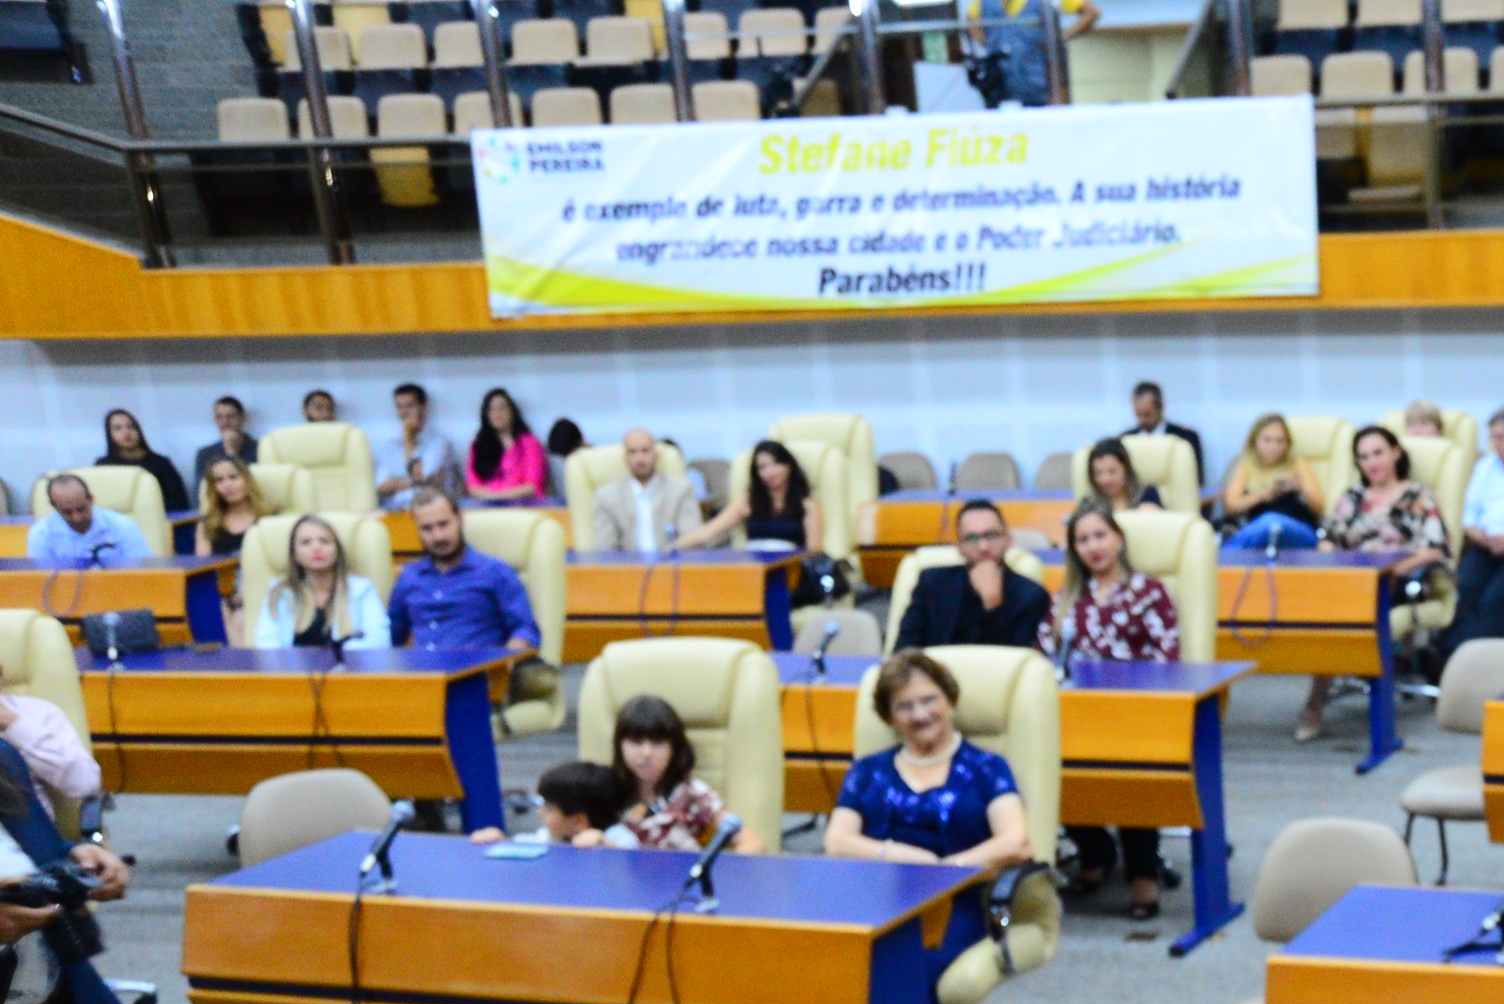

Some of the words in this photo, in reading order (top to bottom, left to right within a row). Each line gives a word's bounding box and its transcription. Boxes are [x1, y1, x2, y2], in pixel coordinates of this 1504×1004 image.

[529, 158, 606, 174] PEREIRA
[757, 132, 911, 175] Stefane
[925, 126, 1029, 168] Fiúza
[696, 195, 724, 217] de
[733, 192, 790, 219] luta,
[796, 194, 862, 222] garra
[870, 195, 886, 212] e
[1070, 179, 1086, 203] A
[1096, 184, 1137, 202] sua
[1146, 173, 1242, 201] história
[766, 234, 839, 257] nossa
[849, 230, 925, 255] cidade
[935, 233, 949, 252] e
[956, 232, 971, 251] o
[977, 225, 1045, 250] Poder
[1054, 219, 1181, 248] Judiciário.
[818, 262, 988, 296] Parabéns!!!
